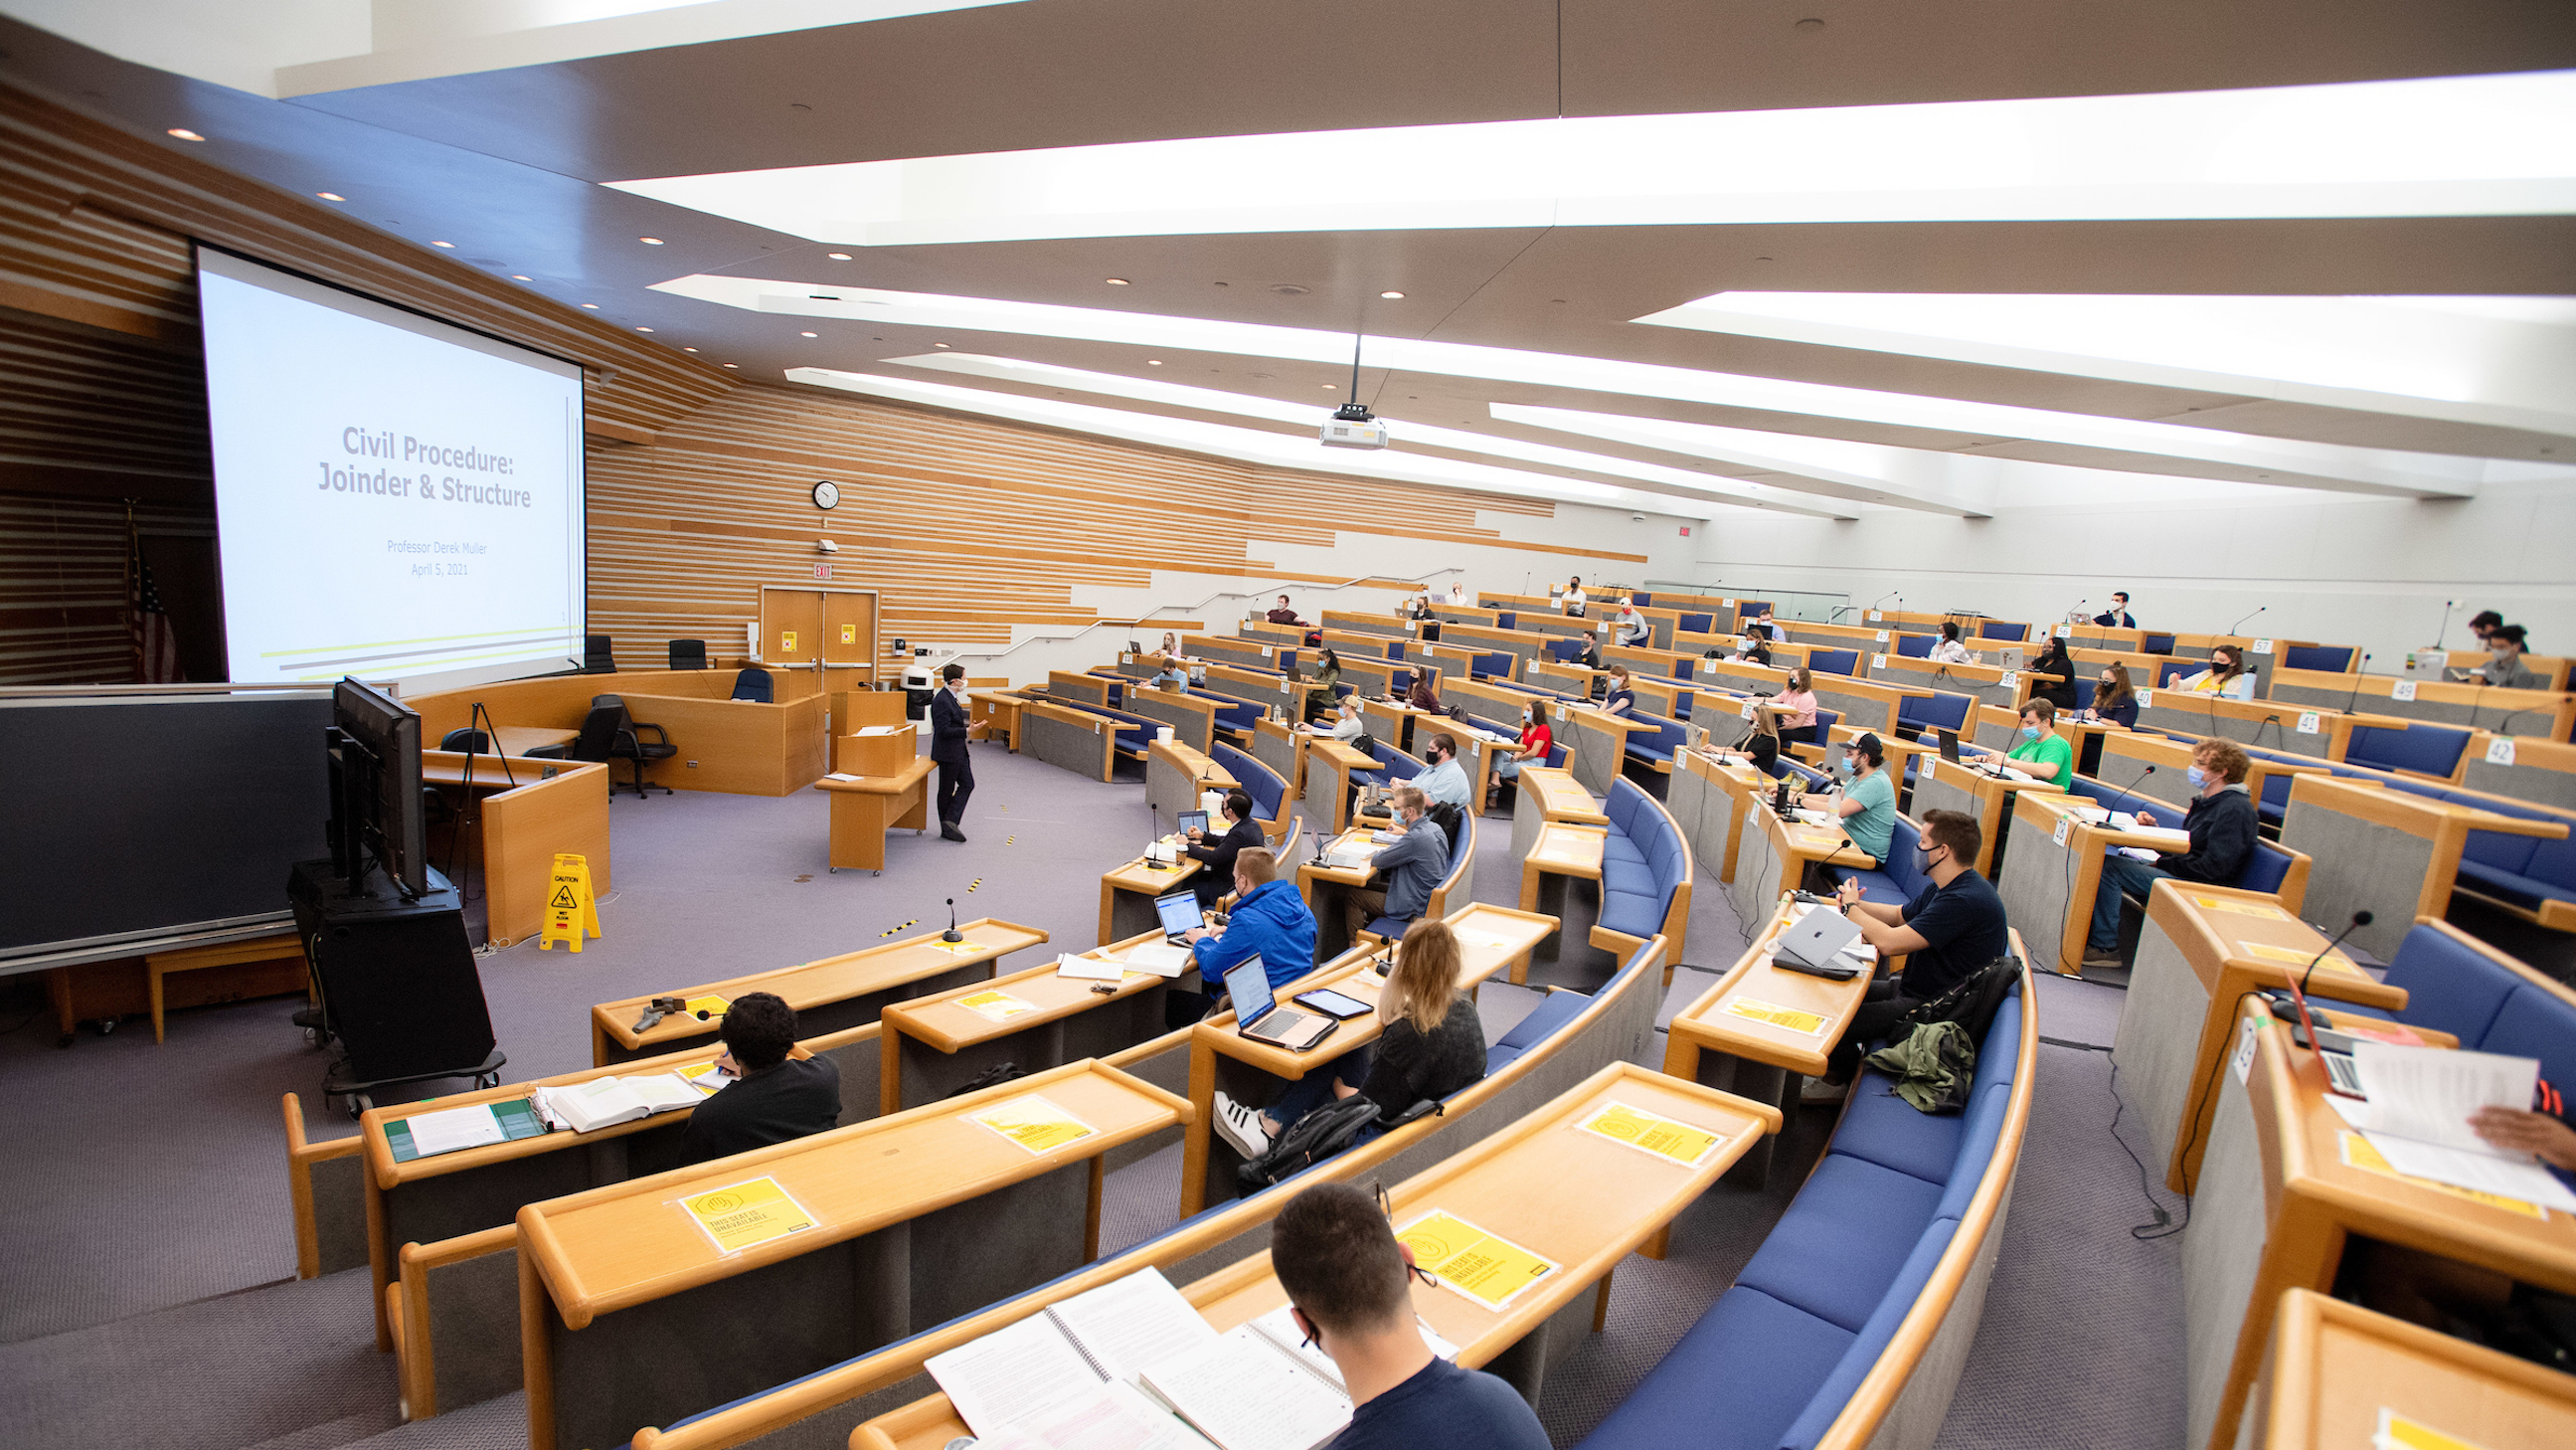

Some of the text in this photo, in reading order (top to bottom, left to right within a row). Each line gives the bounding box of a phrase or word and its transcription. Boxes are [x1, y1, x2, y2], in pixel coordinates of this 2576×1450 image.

[343, 426, 513, 475] Civil Procedure:
[318, 461, 531, 508] Joinder & Structure
[388, 540, 487, 554] Professor Derek Muller
[412, 563, 468, 578] April 5, 2021
[816, 565, 829, 577] EXIT
[2255, 641, 2269, 651] 57
[1875, 656, 1884, 666] 38
[2003, 674, 2014, 685] 39
[2138, 692, 2149, 704] 40
[2398, 685, 2413, 697] 49
[2302, 716, 2315, 730] 41
[2492, 742, 2510, 760] 42
[1925, 760, 1934, 774] 27
[713, 1213, 768, 1232] UNAVAILABLE
[727, 1212, 749, 1221] SEAT
